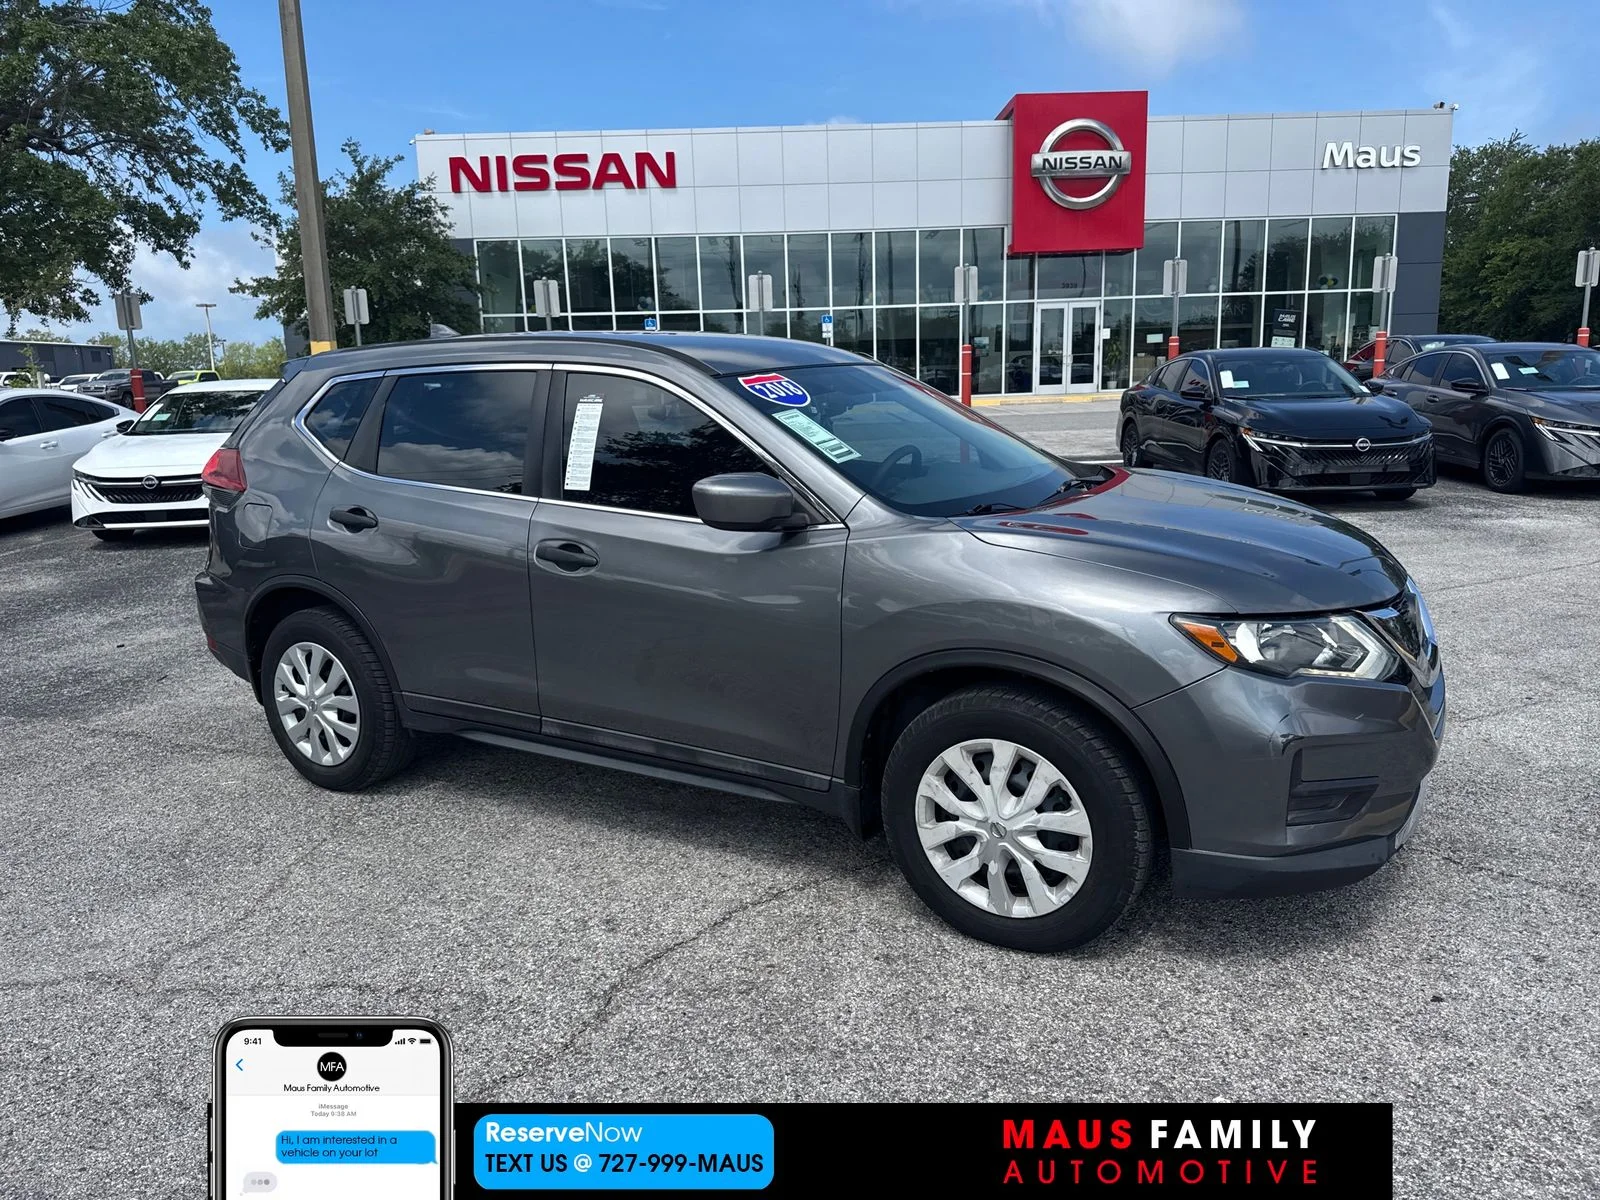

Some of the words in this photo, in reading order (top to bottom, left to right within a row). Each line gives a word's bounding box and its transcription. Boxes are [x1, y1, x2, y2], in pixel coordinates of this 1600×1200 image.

[1042, 155, 1122, 171] NISSAN
[1321, 141, 1421, 169] Maus
[449, 151, 677, 193] NISSAN
[754, 381, 803, 399] 2018
